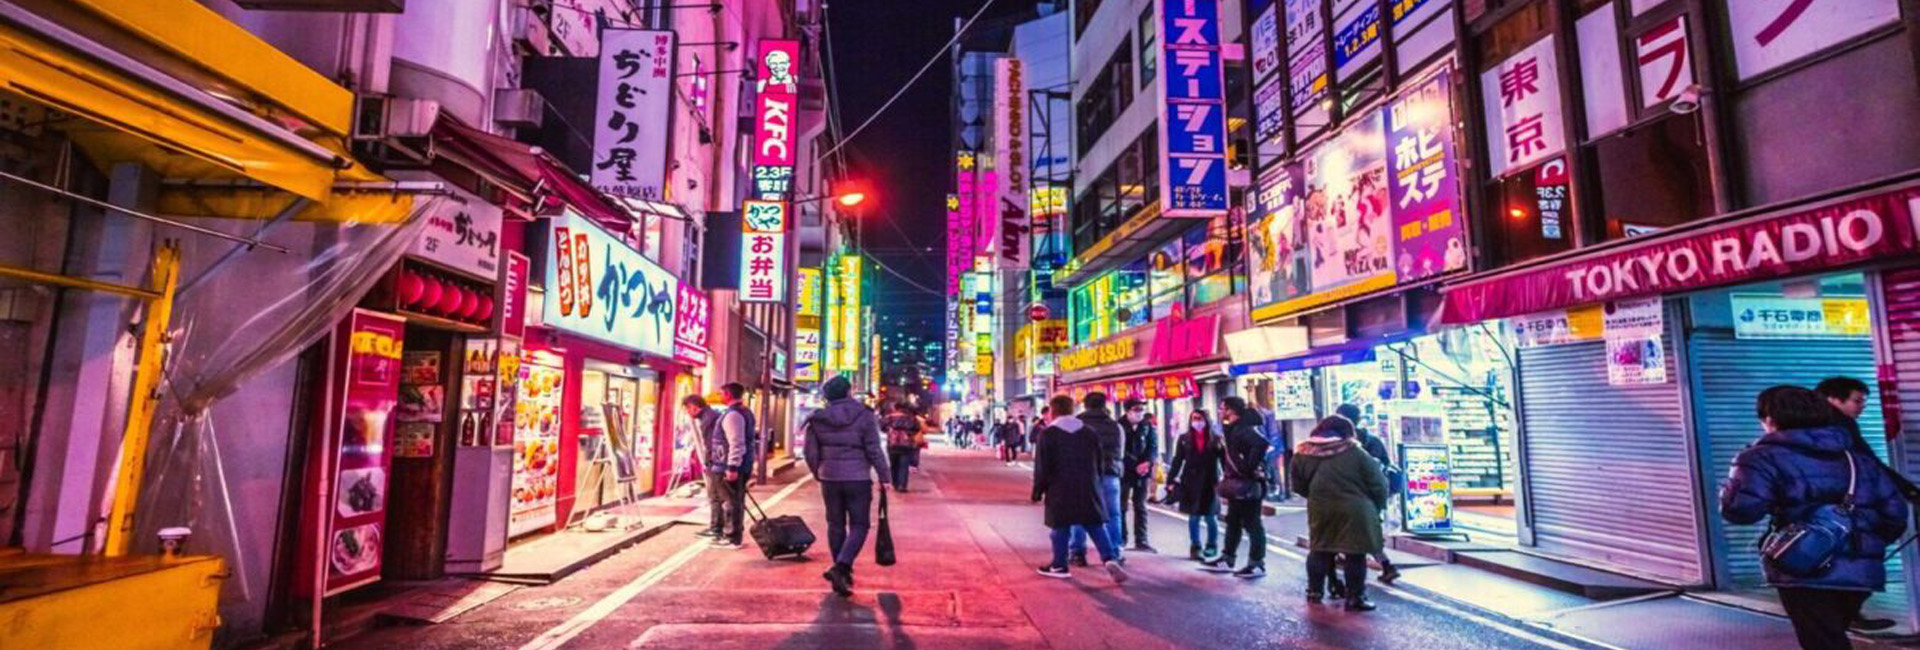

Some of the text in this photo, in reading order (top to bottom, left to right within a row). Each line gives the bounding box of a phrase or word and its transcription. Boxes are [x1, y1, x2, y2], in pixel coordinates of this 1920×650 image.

[596, 49, 652, 181] ぢどり屋
[762, 98, 789, 160] KFC
[1500, 57, 1547, 162] 東京
[597, 243, 673, 345] かつや
[749, 236, 774, 299] お弁当
[1565, 247, 1699, 300] TOKYO
[1711, 209, 1884, 276] RADIO
